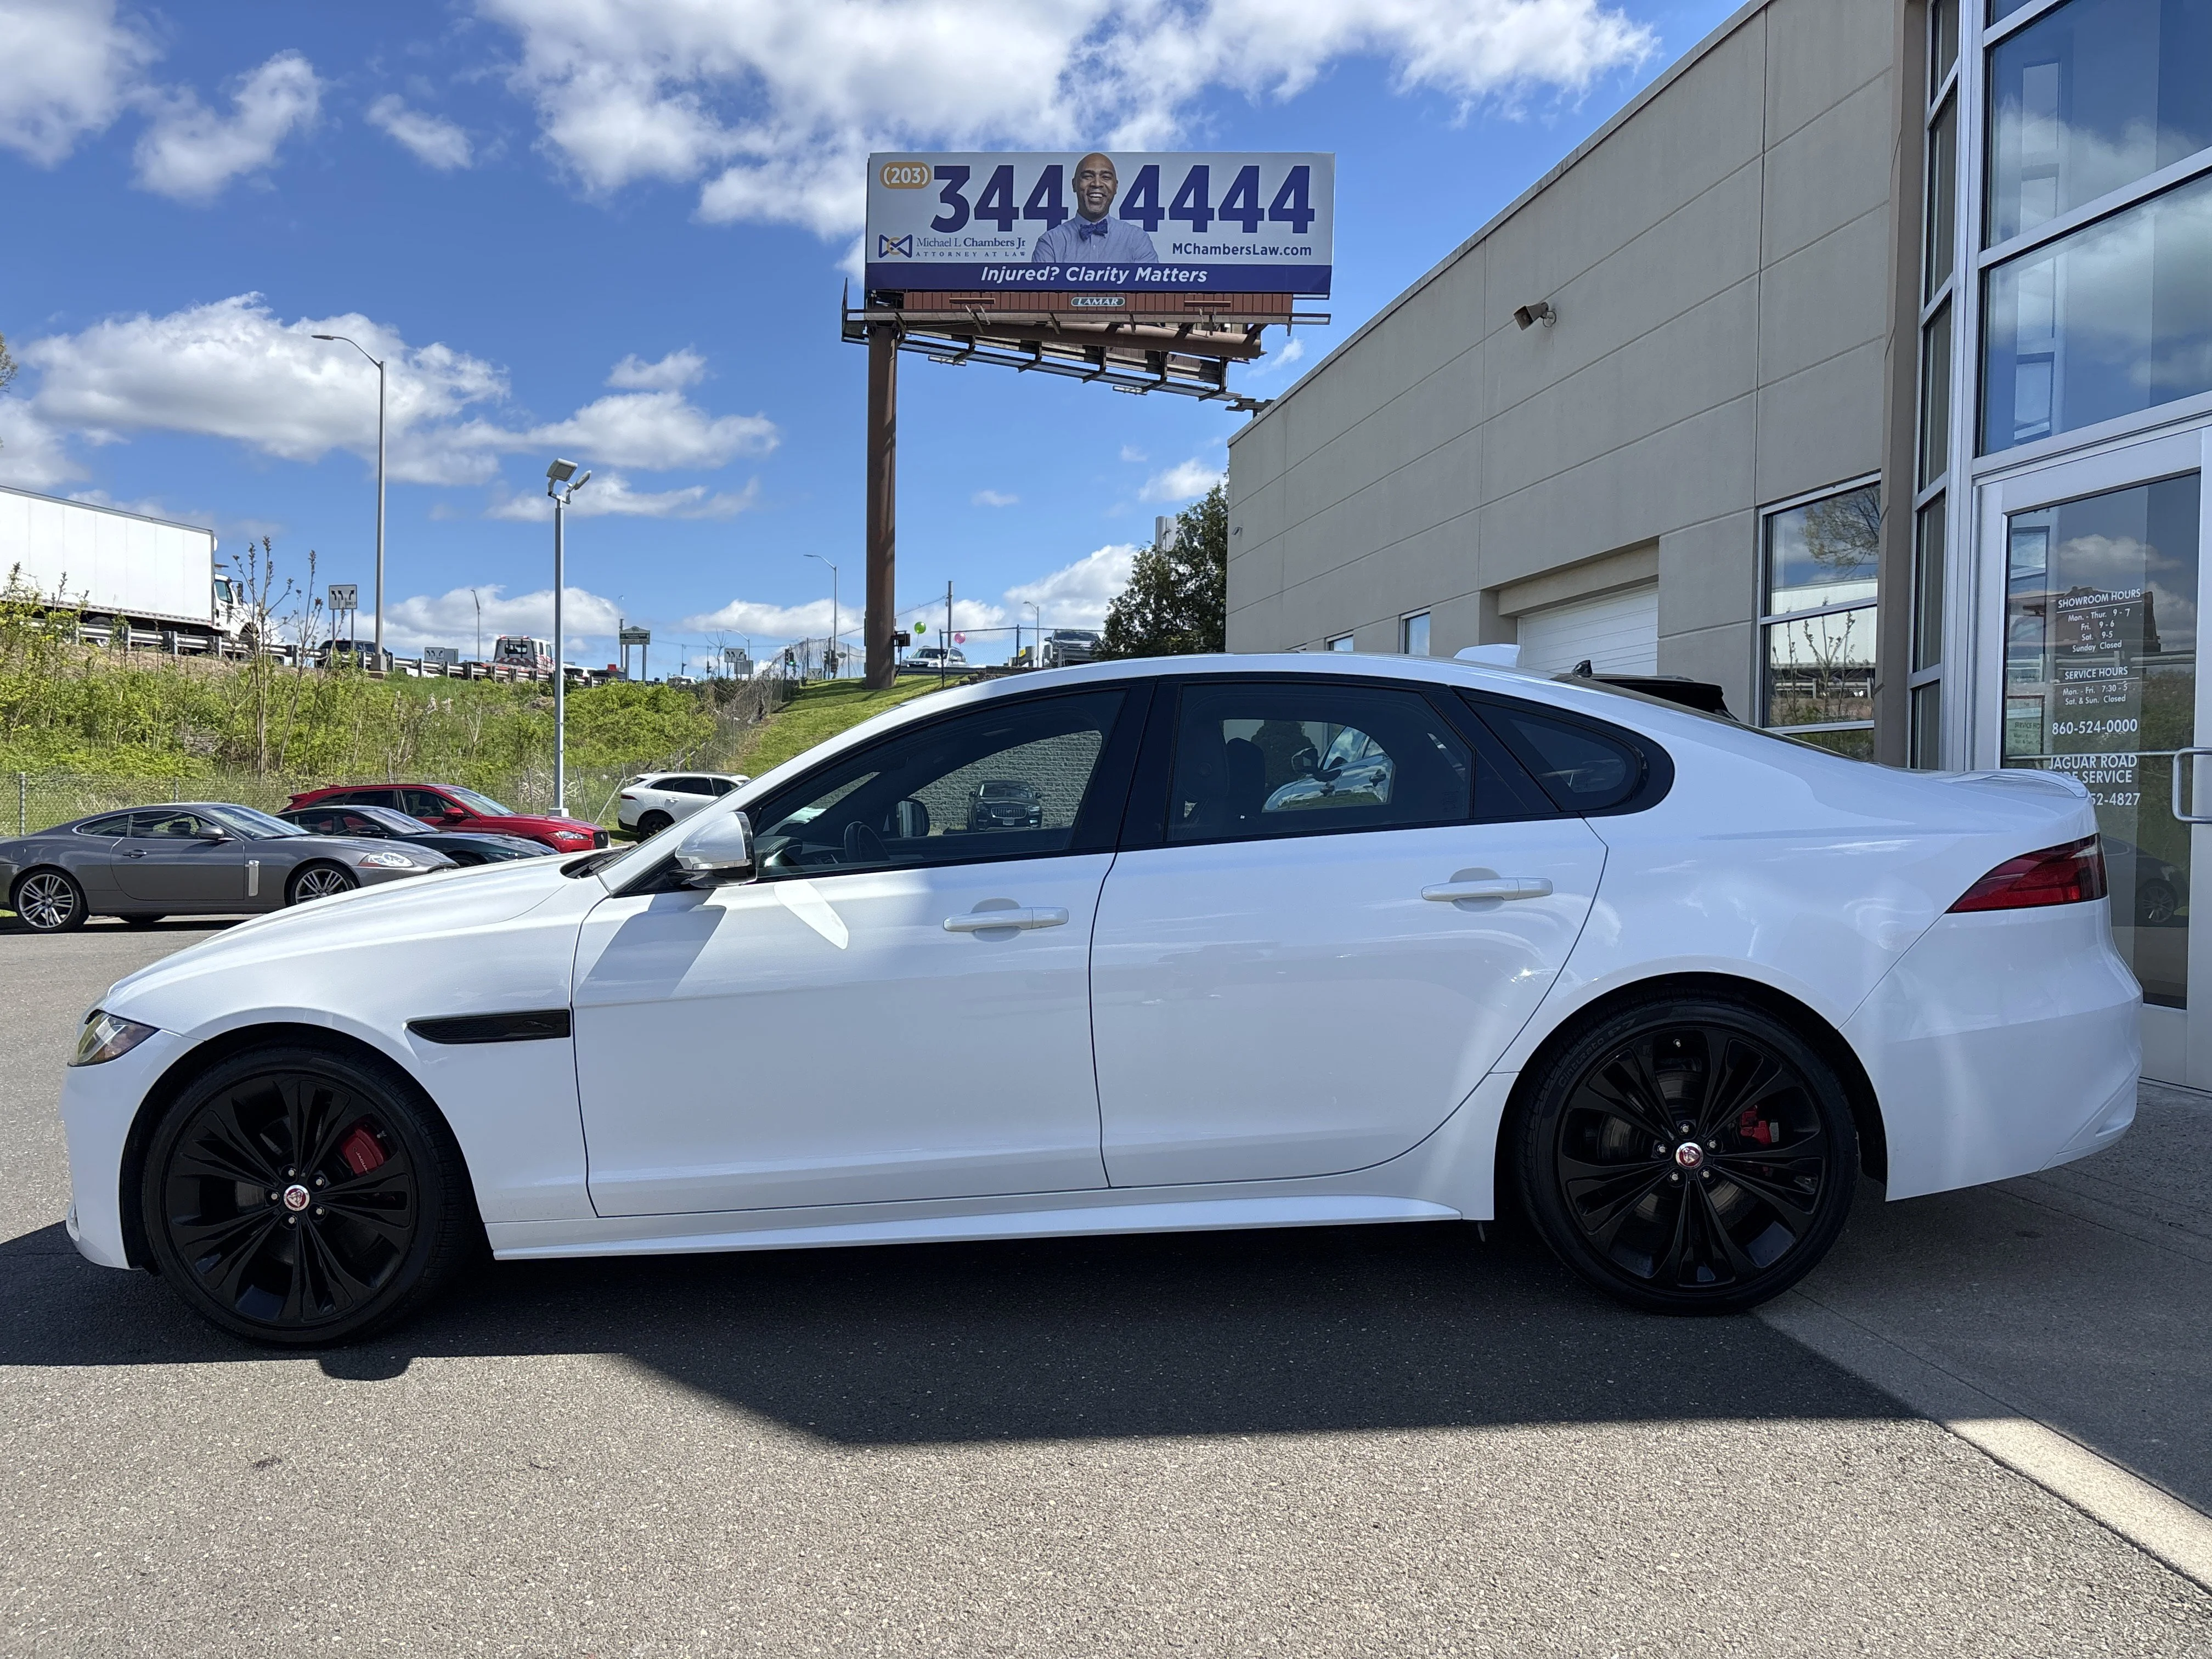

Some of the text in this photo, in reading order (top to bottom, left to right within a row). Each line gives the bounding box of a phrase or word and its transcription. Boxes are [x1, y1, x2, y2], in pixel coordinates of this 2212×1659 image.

[883, 165, 1315, 234] (203) 344 4444
[916, 237, 1026, 249] Michael L Chambers Jr
[1172, 242, 1312, 256] MChambersLaw.com
[981, 266, 1208, 284] Injured? Clarity Matters
[2058, 588, 2141, 608] SHOWROOM HOURS
[2090, 611, 2107, 619] Thur.
[2080, 623, 2091, 631] Fri.
[2081, 633, 2094, 641] Sat.
[2072, 640, 2122, 653] Sunday Closed
[2064, 666, 2128, 680] SERVICE HOURS
[2062, 688, 2079, 696] Mon.
[2085, 686, 2096, 694] Fri.
[2101, 684, 2117, 693] 7:30
[2064, 697, 2077, 706] Sat.
[2078, 697, 2084, 705] &
[2103, 693, 2126, 703] Closed
[2052, 718, 2138, 735] 860-524-0000
[2048, 754, 2137, 770] JAGUAR ROAD
[2082, 770, 2132, 784] SERVICE
[2090, 792, 2141, 806] 52-4827
[356, 1152, 368, 1171] JAGUA
